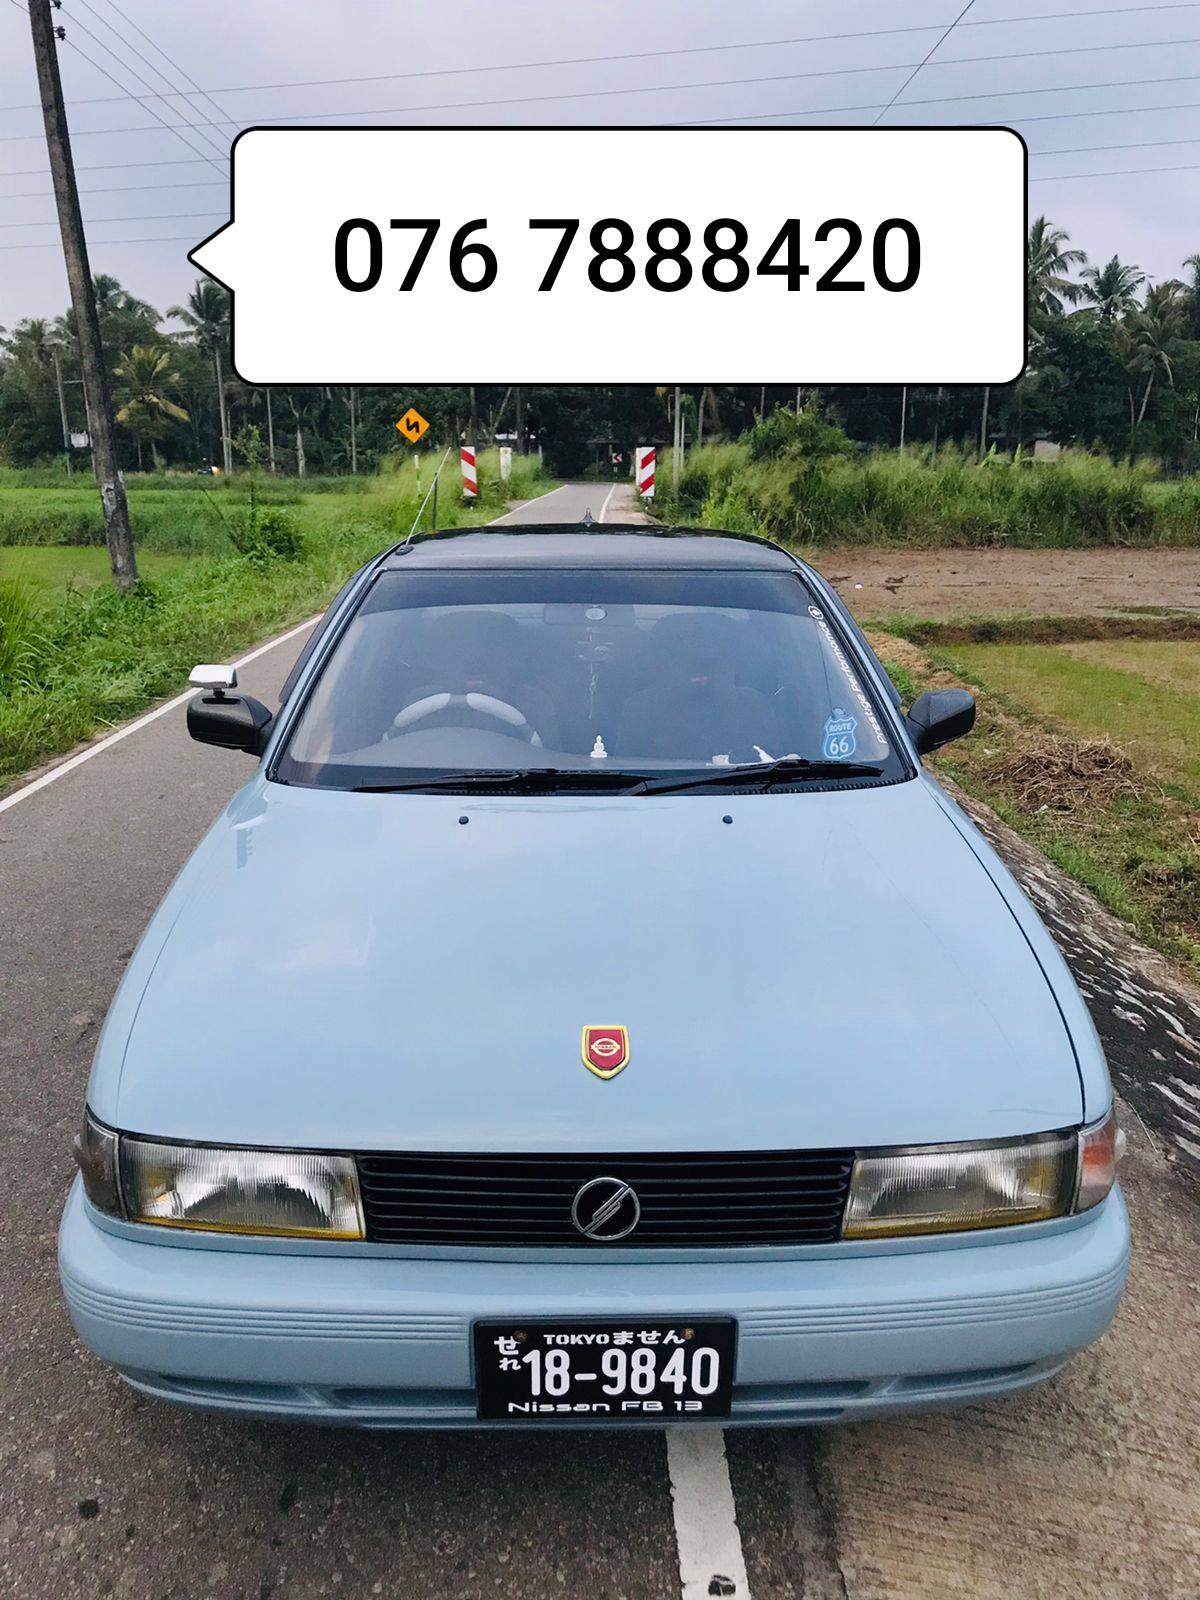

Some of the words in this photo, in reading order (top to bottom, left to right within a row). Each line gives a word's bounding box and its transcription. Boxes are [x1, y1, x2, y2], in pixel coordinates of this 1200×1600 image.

[829, 722, 852, 732] ROUTE
[829, 735, 849, 755] 66
[543, 1333, 610, 1345] TOKYO
[613, 1329, 686, 1345] ません
[522, 1347, 720, 1396] 18-9840
[508, 1401, 610, 1412] Nissan
[622, 1401, 664, 1411] FB
[674, 1400, 703, 1411] 13
